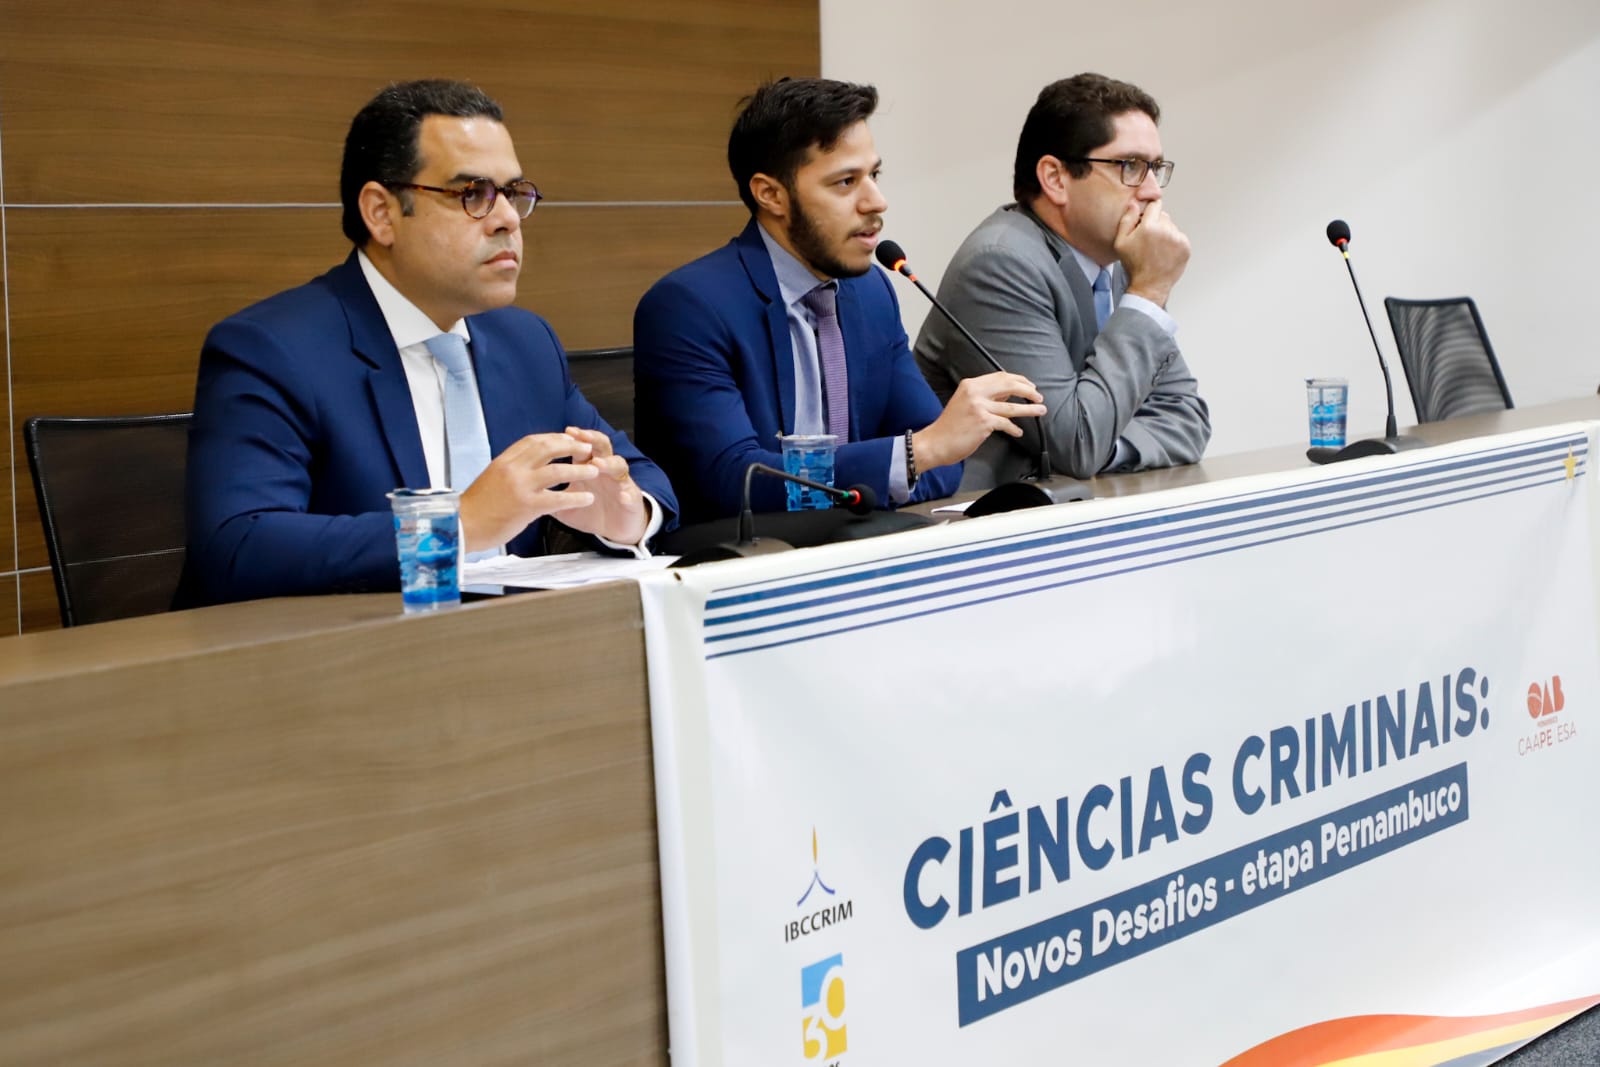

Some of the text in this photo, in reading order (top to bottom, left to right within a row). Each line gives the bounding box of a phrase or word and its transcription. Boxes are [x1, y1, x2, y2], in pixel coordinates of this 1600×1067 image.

[903, 667, 1489, 930] CIÊNCIAS CRIMINAIS:
[1518, 728, 1553, 756] CAAPE
[1557, 721, 1577, 743] ESA
[784, 900, 853, 943] IBCCRIM
[976, 929, 1082, 1002] Novos
[1092, 874, 1218, 956] Desafios
[1241, 839, 1314, 895] etapa
[1320, 782, 1461, 864] Pernambuco
